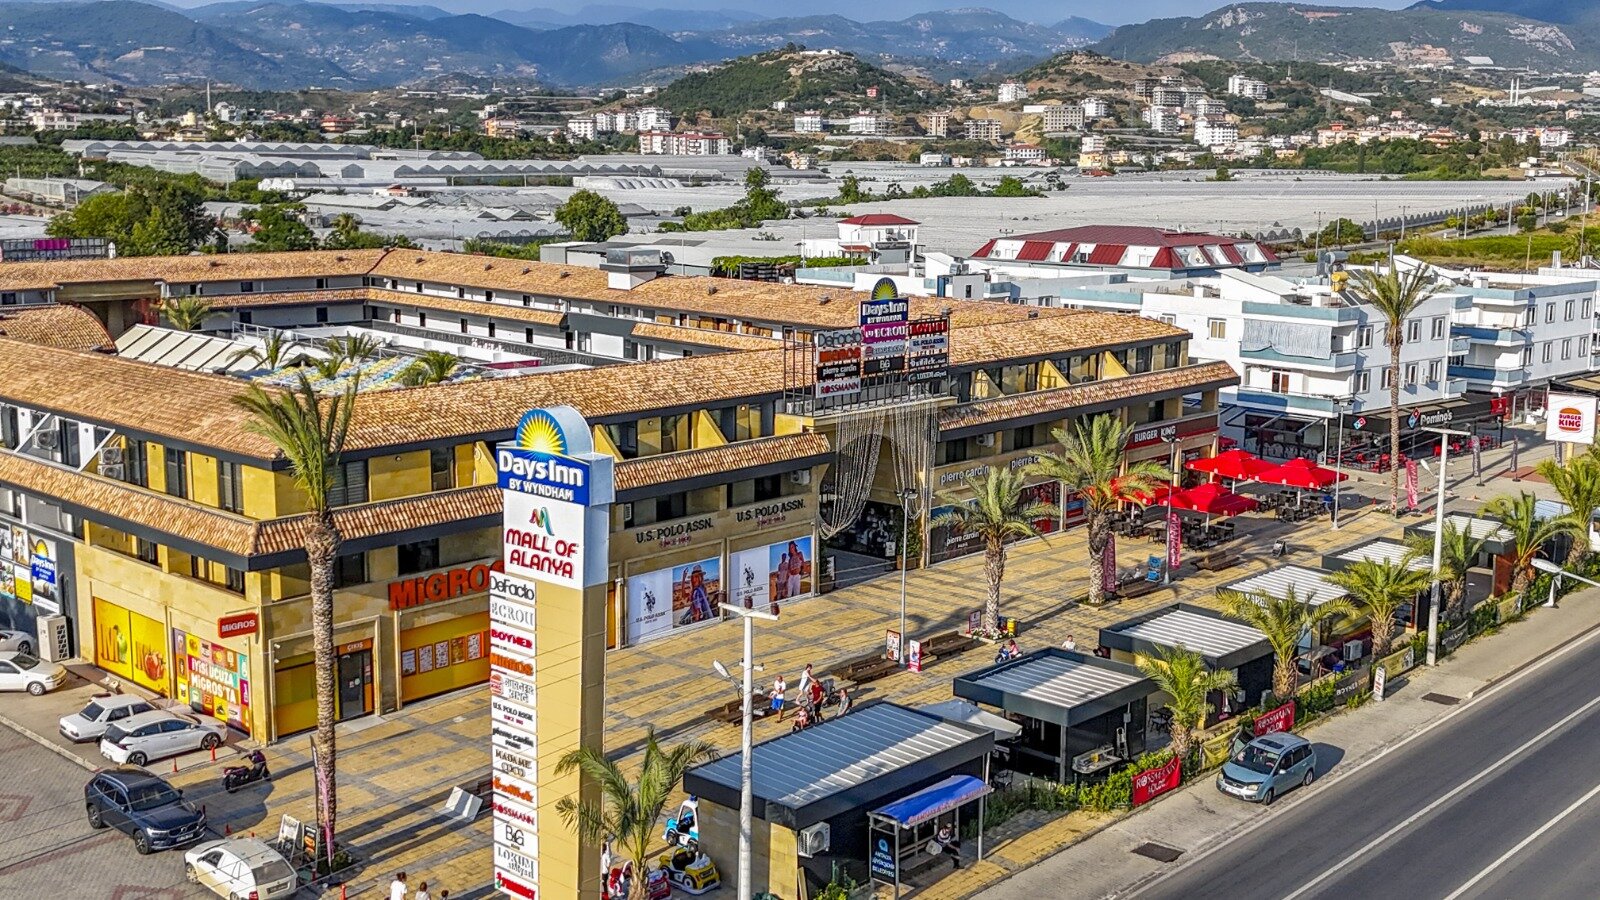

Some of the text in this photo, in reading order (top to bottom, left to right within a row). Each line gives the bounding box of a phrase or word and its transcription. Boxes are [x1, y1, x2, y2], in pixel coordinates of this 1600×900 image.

[818, 330, 861, 347] DeFacto
[821, 382, 860, 394] ROSSMANN
[1134, 425, 1176, 443] BURGER KING
[498, 450, 584, 487] Days Inn
[1011, 456, 1036, 470] pierre
[940, 464, 990, 486] pierre cardin
[509, 478, 574, 501] BY WYNDHAM
[736, 499, 806, 523] U.S. POLO ASSN.
[635, 518, 714, 544] U.S. POLO ASSN.
[506, 528, 578, 558] MALL OF
[509, 549, 574, 579] ALANYA
[490, 575, 535, 600] DeFacto
[221, 620, 256, 632] MIGROS
[493, 702, 502, 711] U.S.
[503, 705, 518, 716] POLO
[495, 748, 532, 769] MADAME
[492, 802, 535, 826] ROSSMANN
